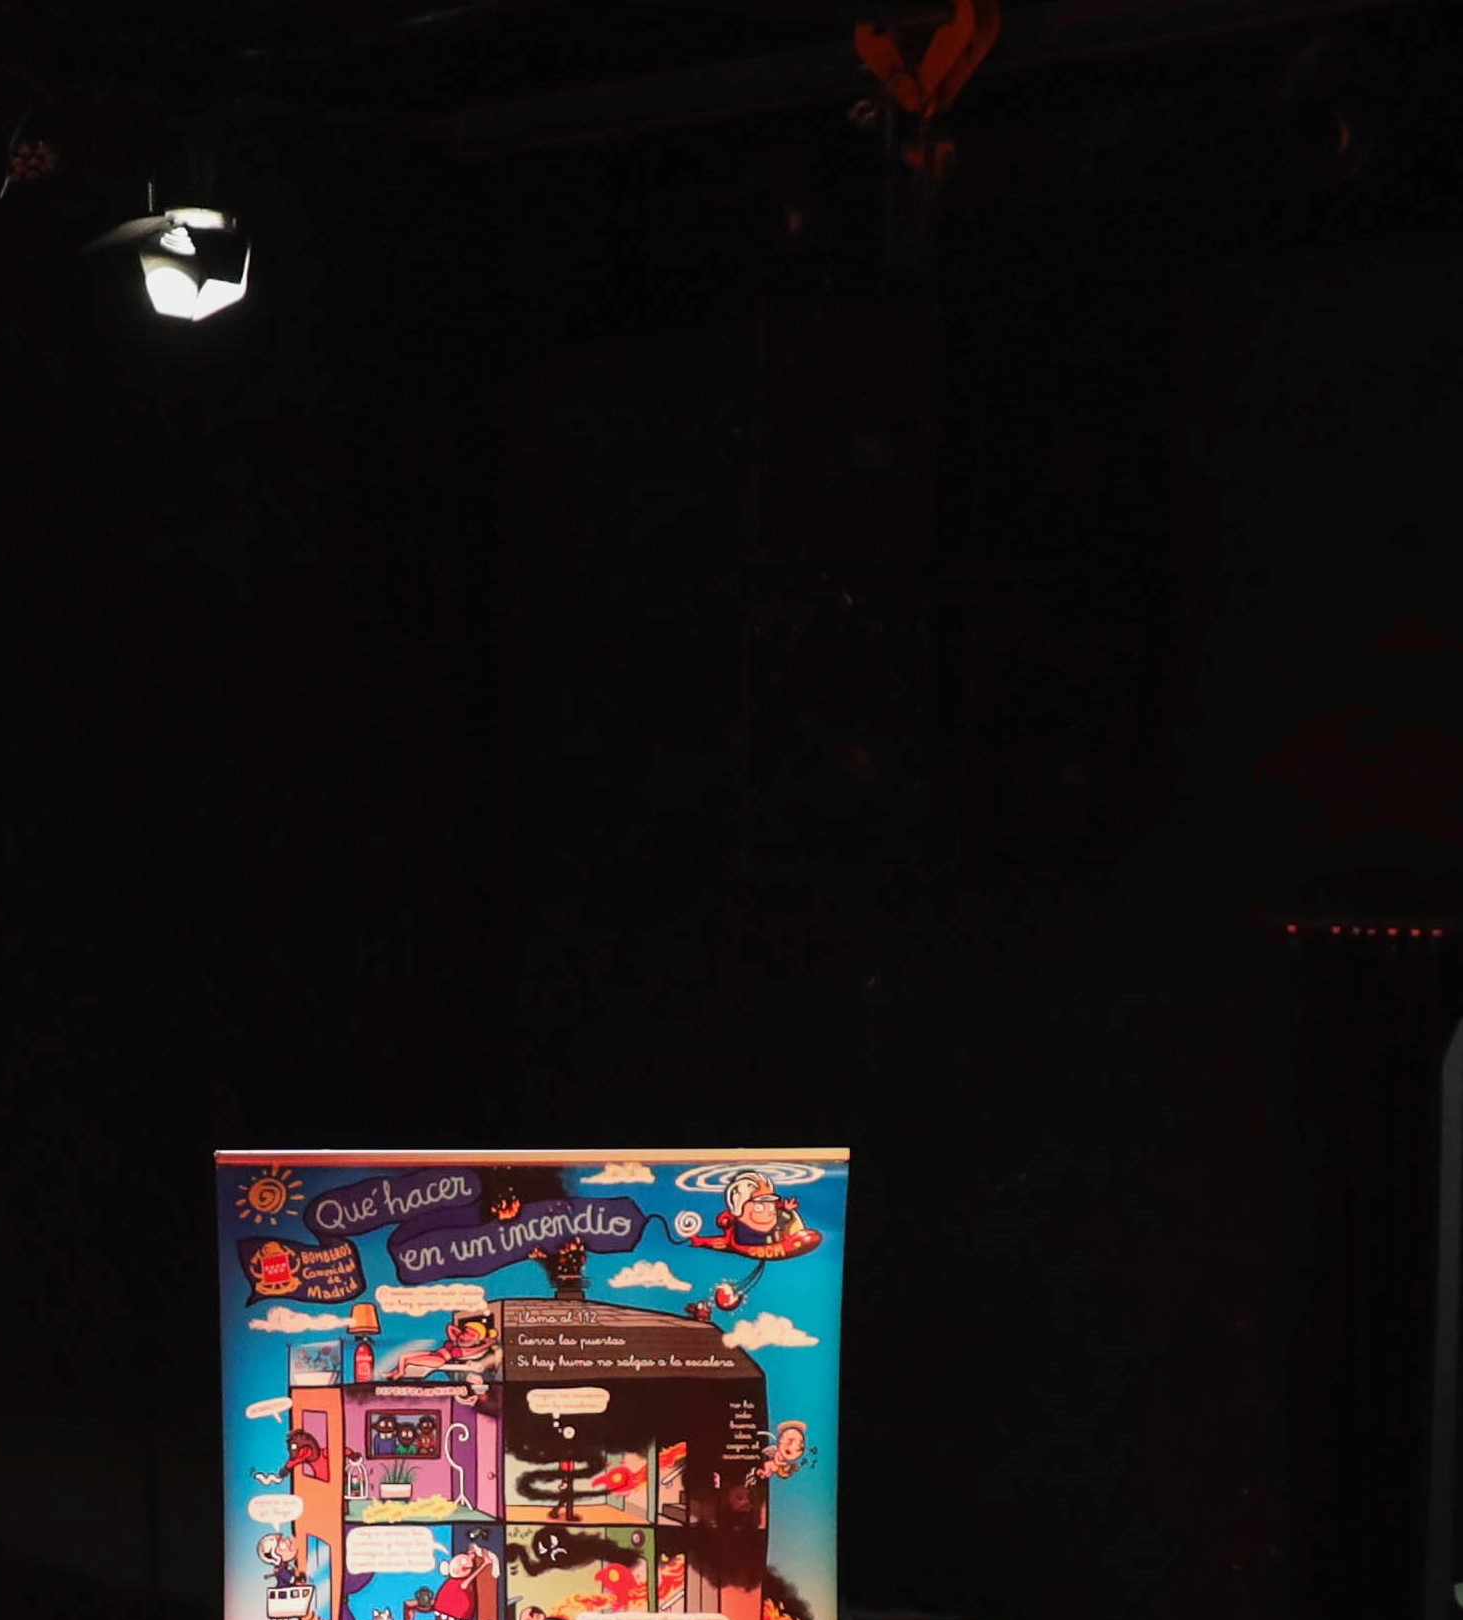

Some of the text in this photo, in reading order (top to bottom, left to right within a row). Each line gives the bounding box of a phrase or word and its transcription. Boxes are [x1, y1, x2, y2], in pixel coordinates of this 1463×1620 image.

[315, 1175, 473, 1231] Qué hacer
[399, 1203, 632, 1270] en un incendio
[300, 1242, 352, 1264] BOMBEROS
[302, 1258, 356, 1279] Comunidad
[307, 1276, 358, 1299] Madrid
[518, 1310, 598, 1325] Llama al 112
[518, 1333, 627, 1350] Cierra las puertas
[517, 1354, 736, 1372] Si hay humo no salgas a la escalera
